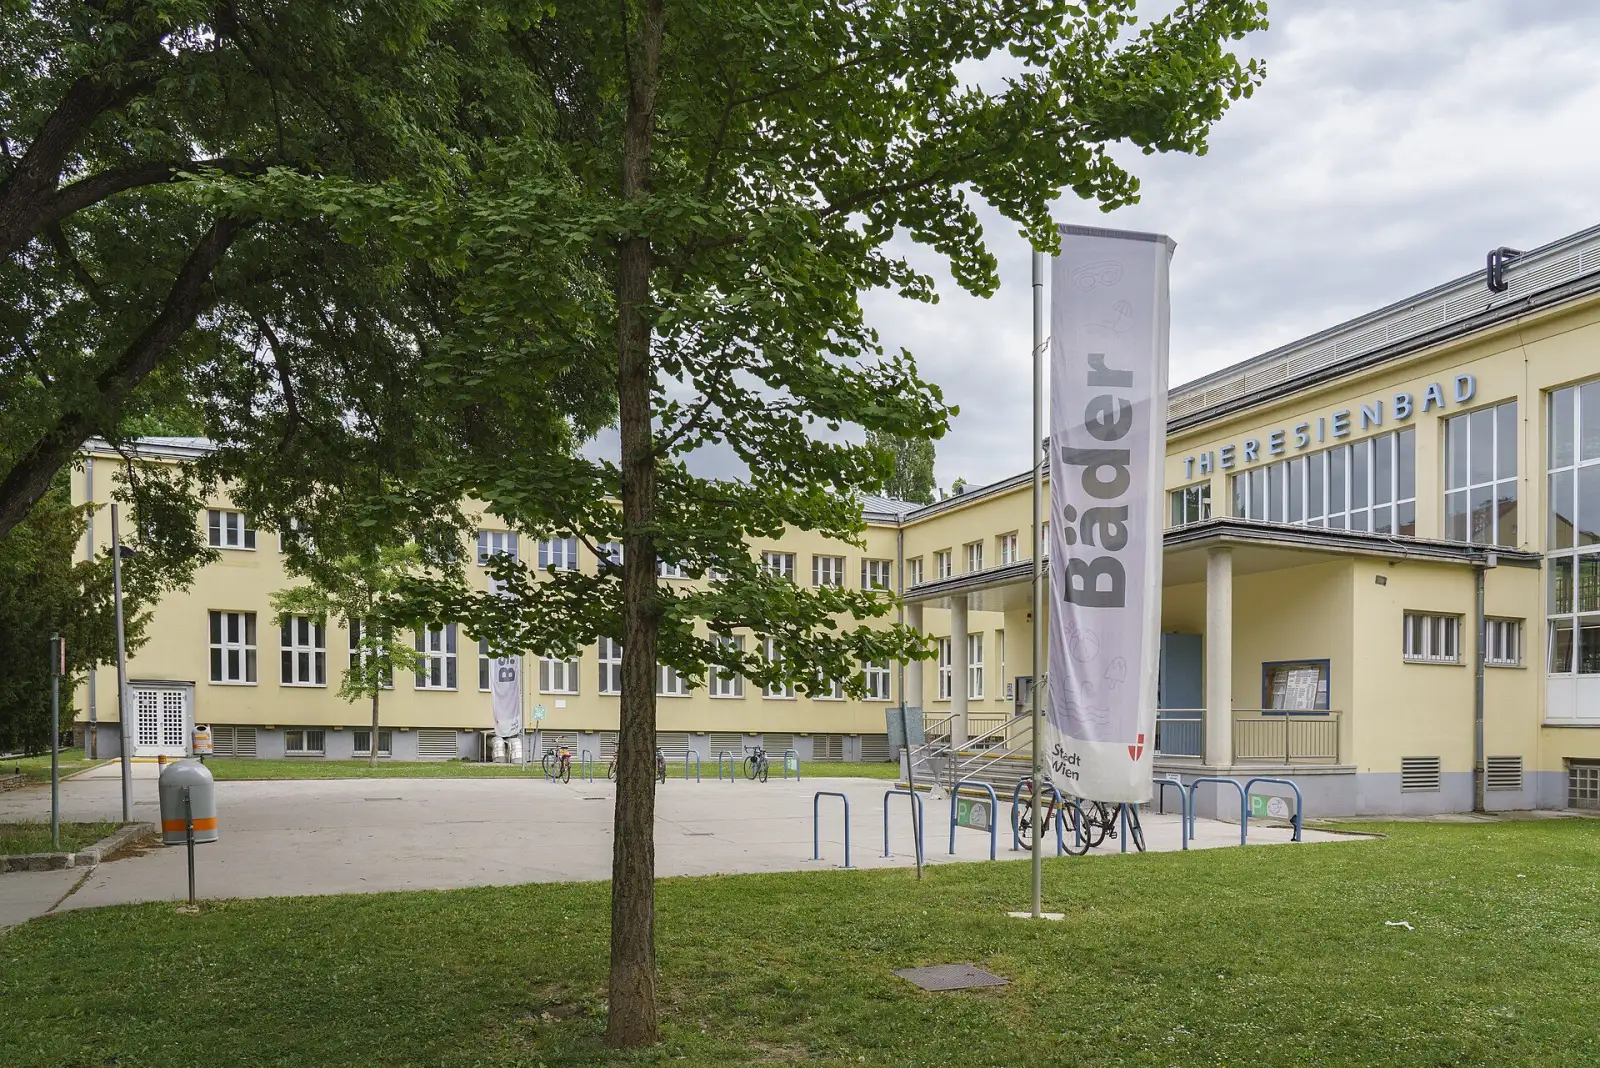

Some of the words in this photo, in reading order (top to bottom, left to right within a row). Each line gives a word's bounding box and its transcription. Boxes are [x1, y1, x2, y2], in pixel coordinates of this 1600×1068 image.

[1183, 373, 1476, 479] THERESIENBAD
[1061, 353, 1133, 608] Bäder
[957, 802, 967, 823] P
[1252, 796, 1263, 815] P
